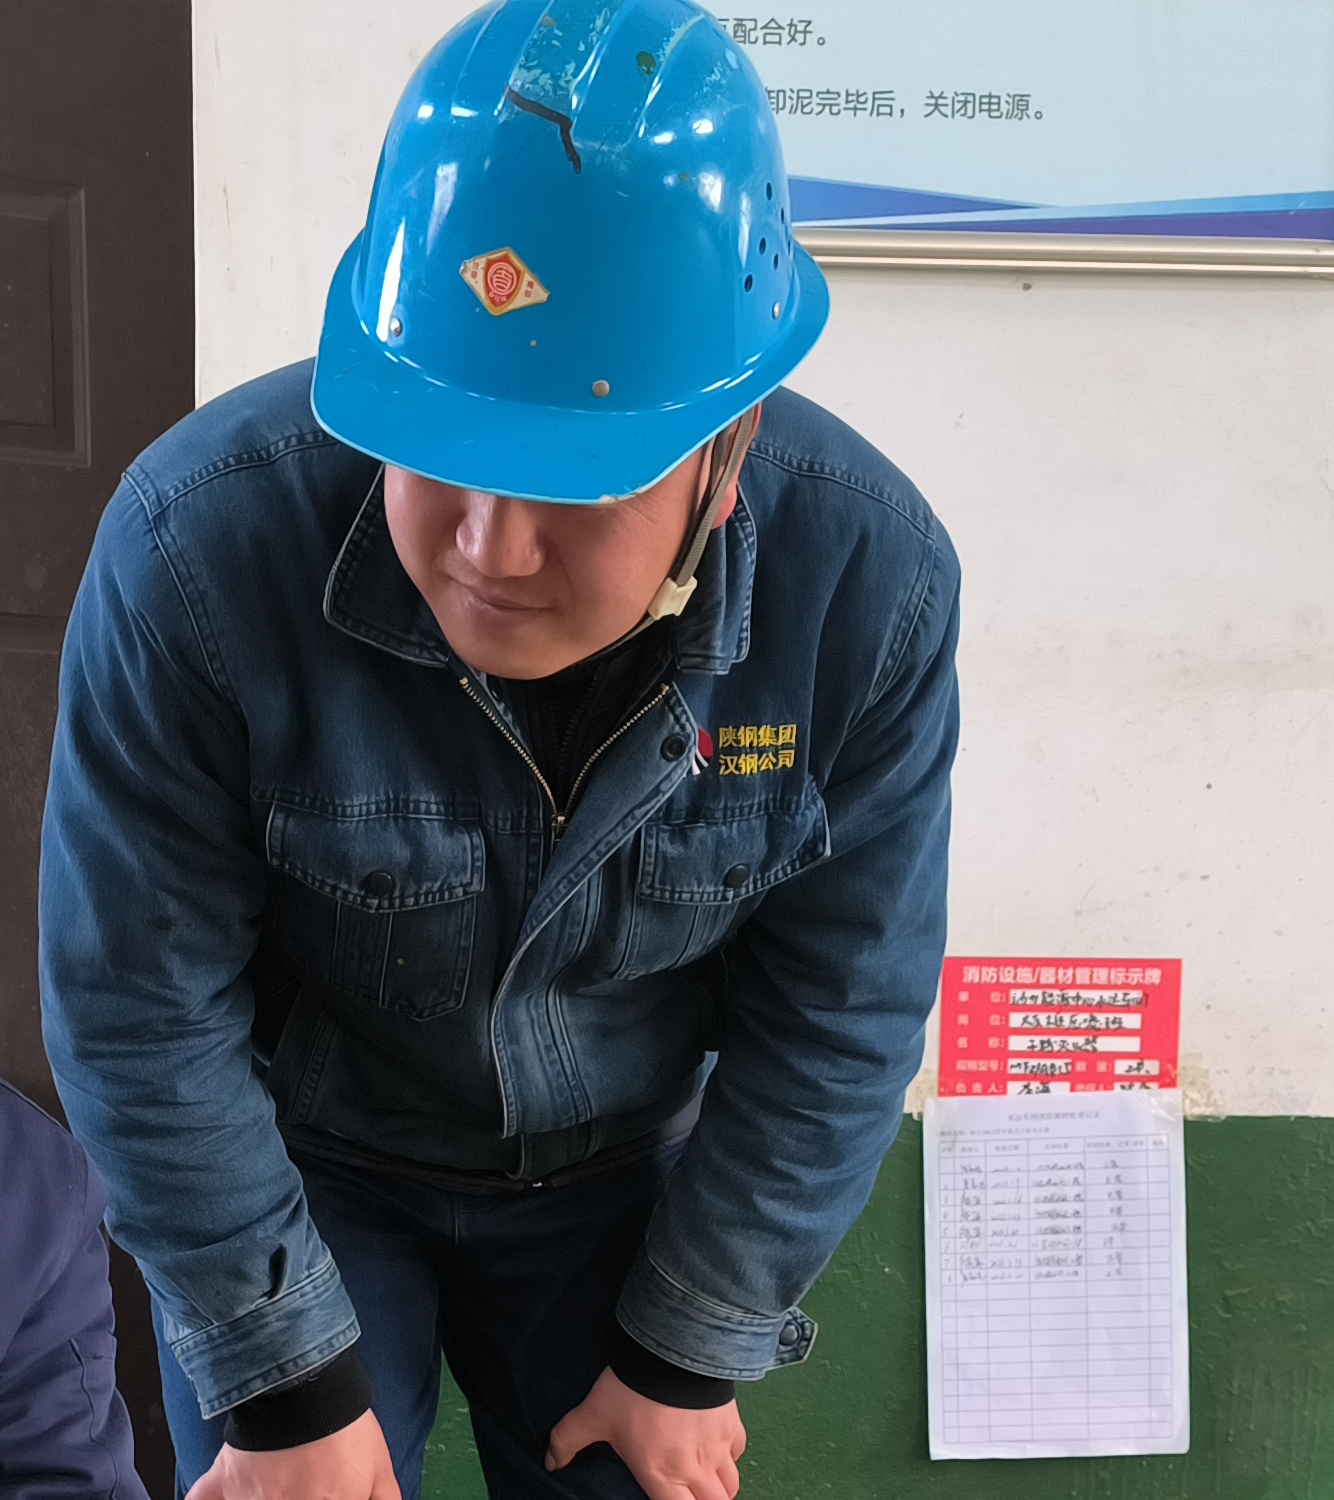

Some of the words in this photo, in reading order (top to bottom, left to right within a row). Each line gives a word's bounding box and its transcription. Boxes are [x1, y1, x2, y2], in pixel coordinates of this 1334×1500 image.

[718, 18, 827, 46] 配合好。
[719, 724, 797, 748] 陕钢集团
[719, 750, 795, 775] 汉钢公司
